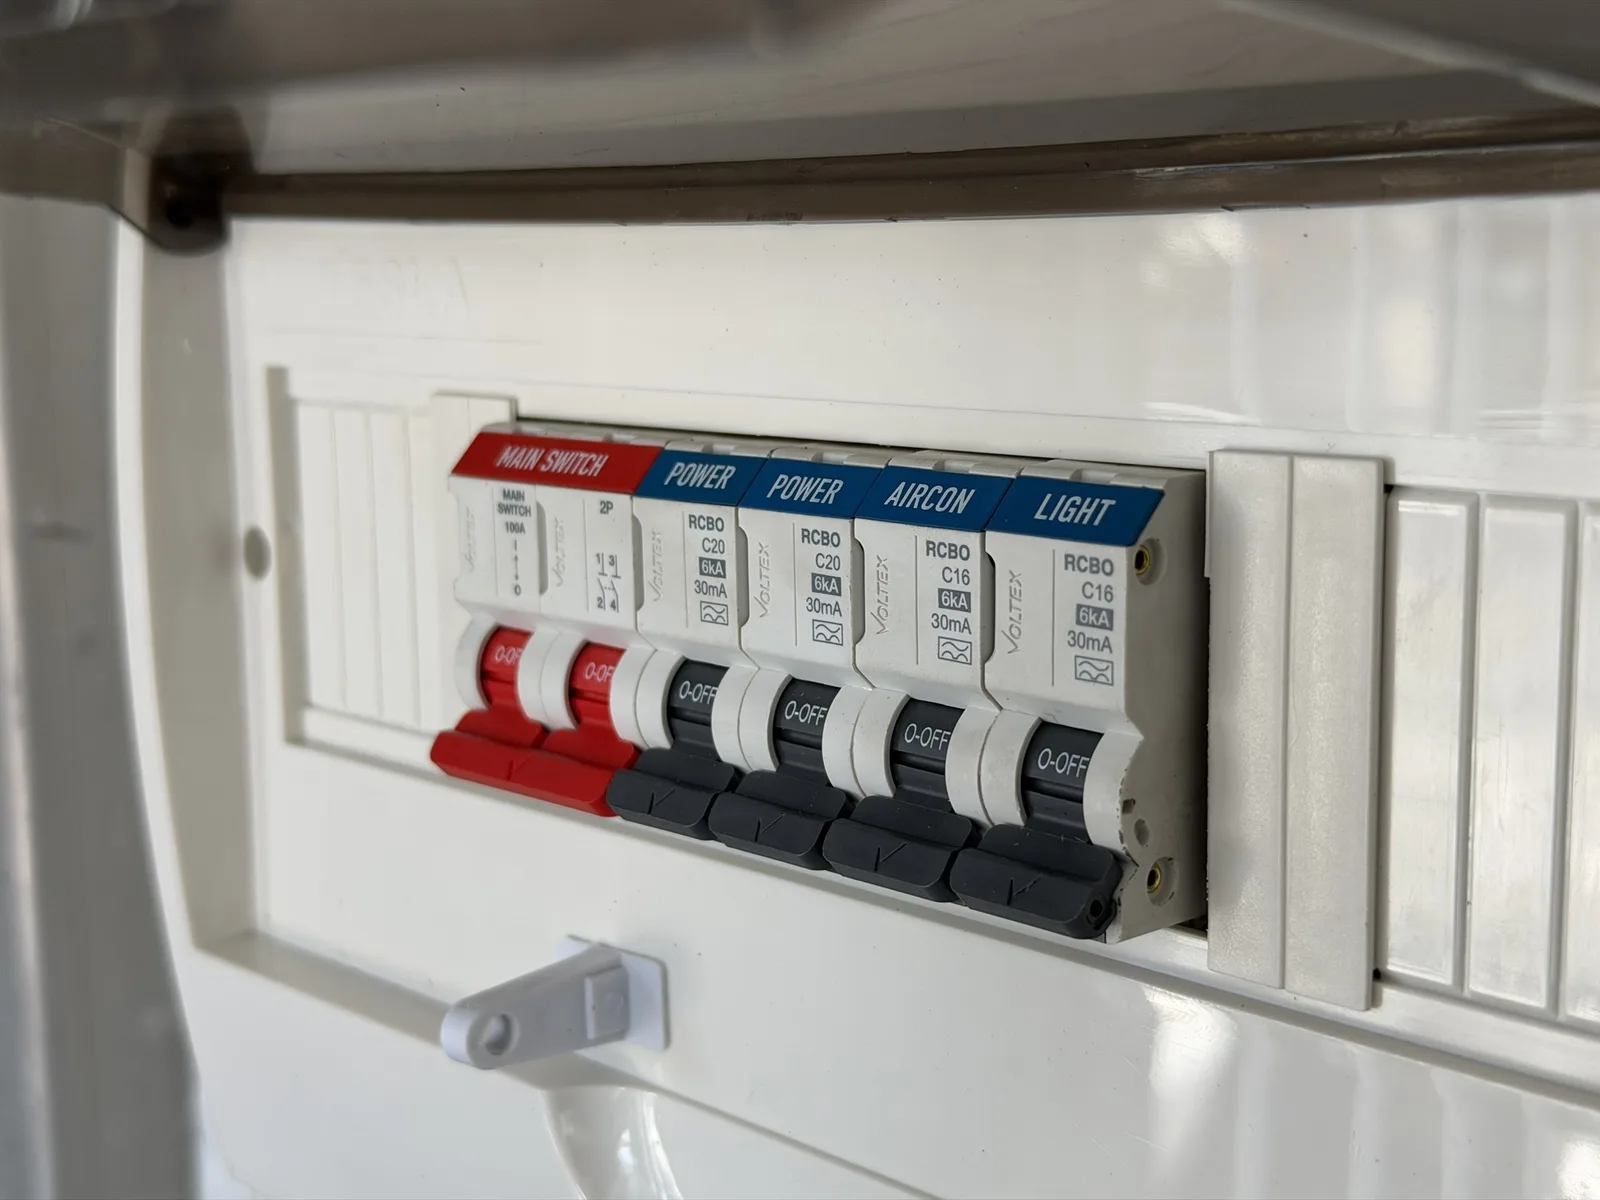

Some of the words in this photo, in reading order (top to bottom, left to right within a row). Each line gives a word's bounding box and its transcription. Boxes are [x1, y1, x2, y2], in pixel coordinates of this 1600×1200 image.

[496, 446, 545, 470] MAIN
[541, 449, 608, 477] SWITCH
[664, 462, 736, 489] POWER
[503, 488, 525, 501] MAIN
[767, 474, 844, 504] POWER
[884, 482, 976, 514] AIRCON
[498, 503, 532, 517] SWITCH
[600, 501, 613, 514] 2P
[1034, 494, 1117, 526] LIGHT
[505, 521, 526, 534] 100A
[689, 514, 725, 532] RCBO
[702, 537, 725, 554] C20
[801, 528, 840, 548] RCBO
[926, 540, 970, 561] RCBO
[702, 560, 724, 576] 6kA
[815, 553, 841, 571] C20
[1064, 553, 1114, 576] RCBO
[814, 577, 839, 594] 6kA
[942, 566, 970, 585] C16
[694, 580, 728, 599] 30mA
[1081, 581, 1114, 603] C16
[806, 597, 842, 617] 30mA
[941, 592, 968, 610] 6kA
[931, 613, 972, 635] 30mA
[1079, 607, 1110, 627] 6kA
[1067, 630, 1113, 654] 30mA
[585, 662, 614, 683] O-OF
